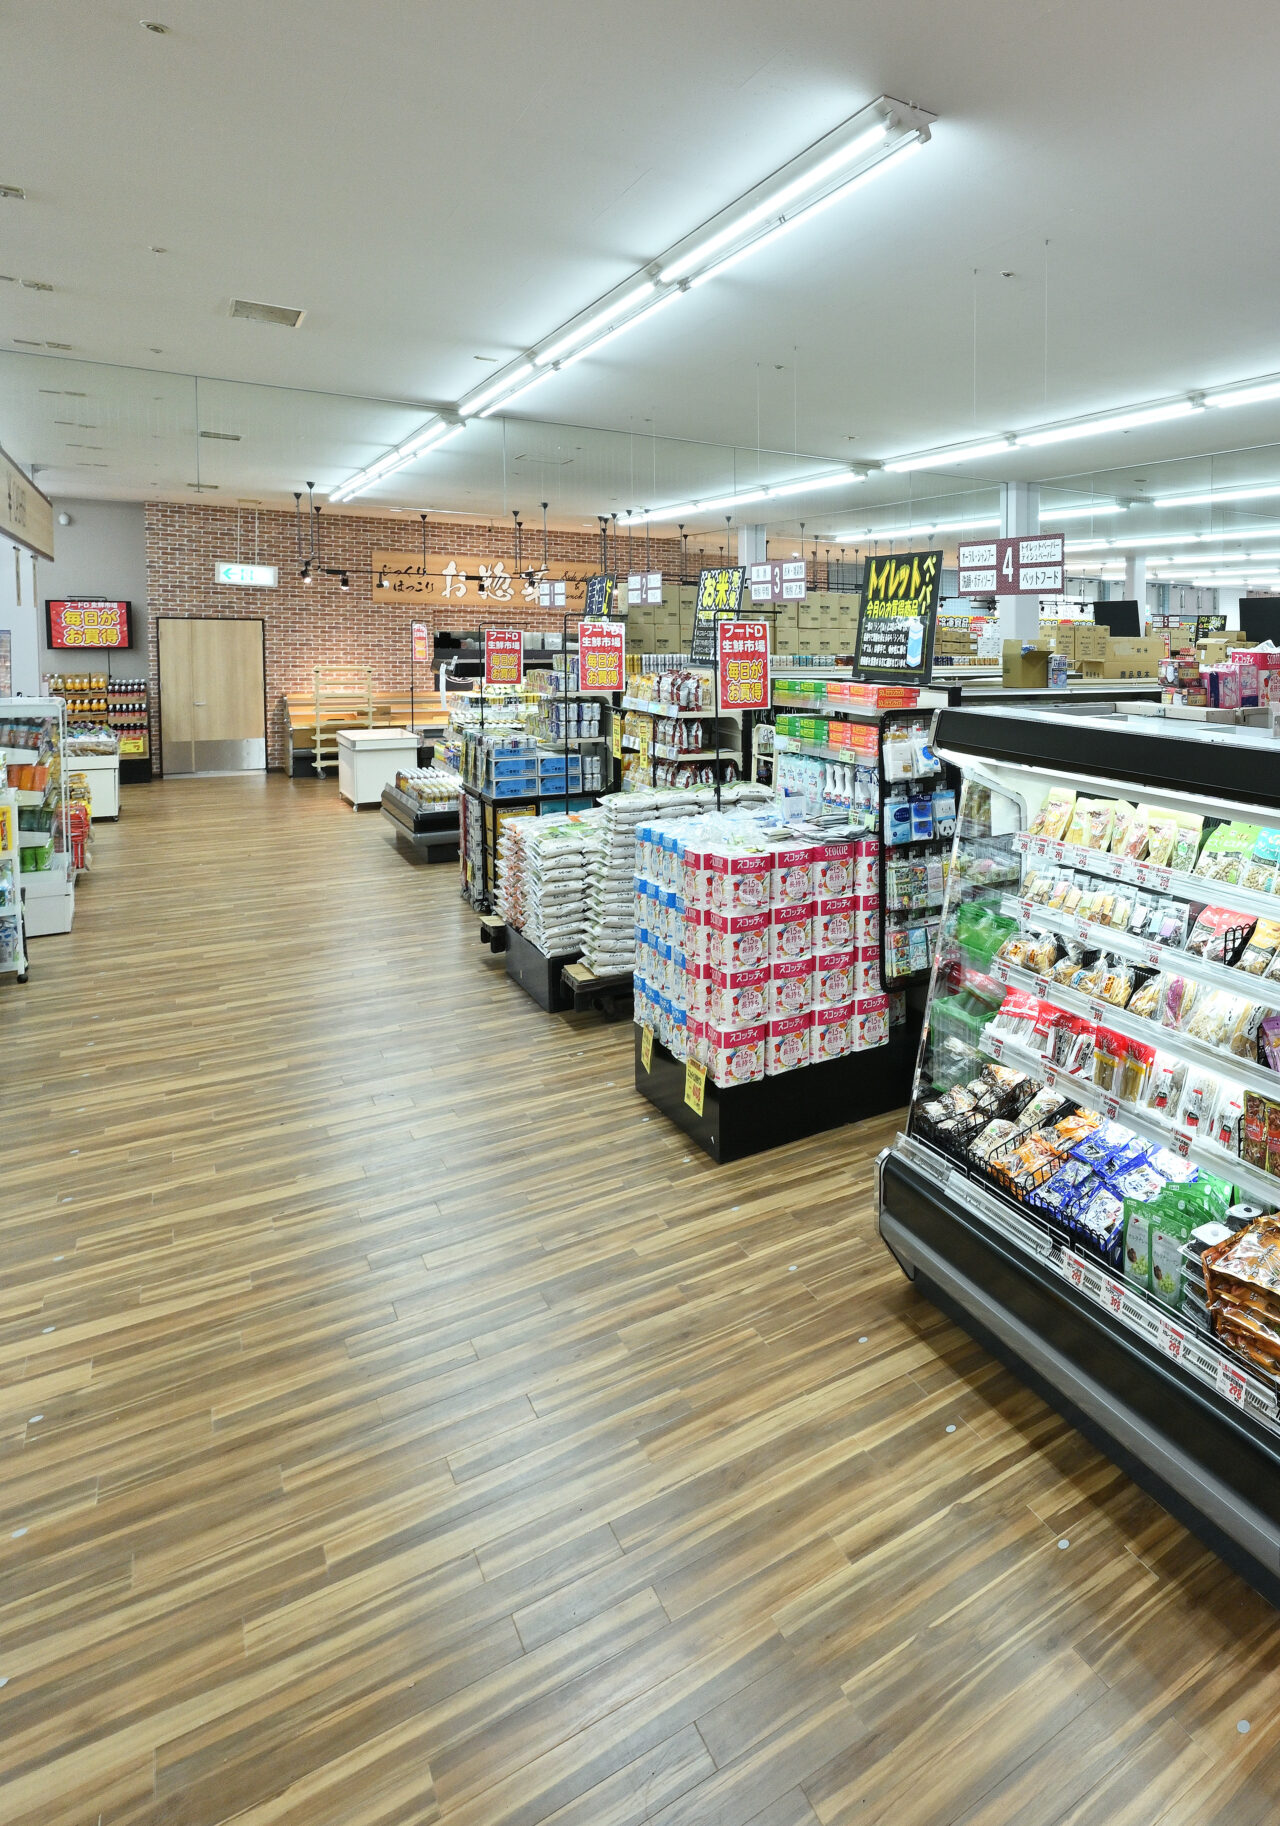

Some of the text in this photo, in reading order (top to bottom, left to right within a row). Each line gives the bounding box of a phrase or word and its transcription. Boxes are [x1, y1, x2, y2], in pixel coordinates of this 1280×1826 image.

[1002, 546, 1014, 582] 4
[642, 577, 647, 599] 2
[774, 567, 780, 594] 3
[868, 556, 922, 600] トイレット
[918, 555, 937, 615] ペーパー
[1022, 570, 1059, 585] ペットフード
[702, 570, 729, 608] お米
[63, 609, 120, 627] 毎日が
[64, 627, 120, 645] お買得
[724, 626, 763, 637] フードD
[722, 639, 766, 653] 生鮮市場
[726, 660, 764, 681] 毎日が
[727, 682, 764, 703] お買得
[1168, 1340, 1180, 1356] 298
[1228, 1383, 1242, 1400] 298
